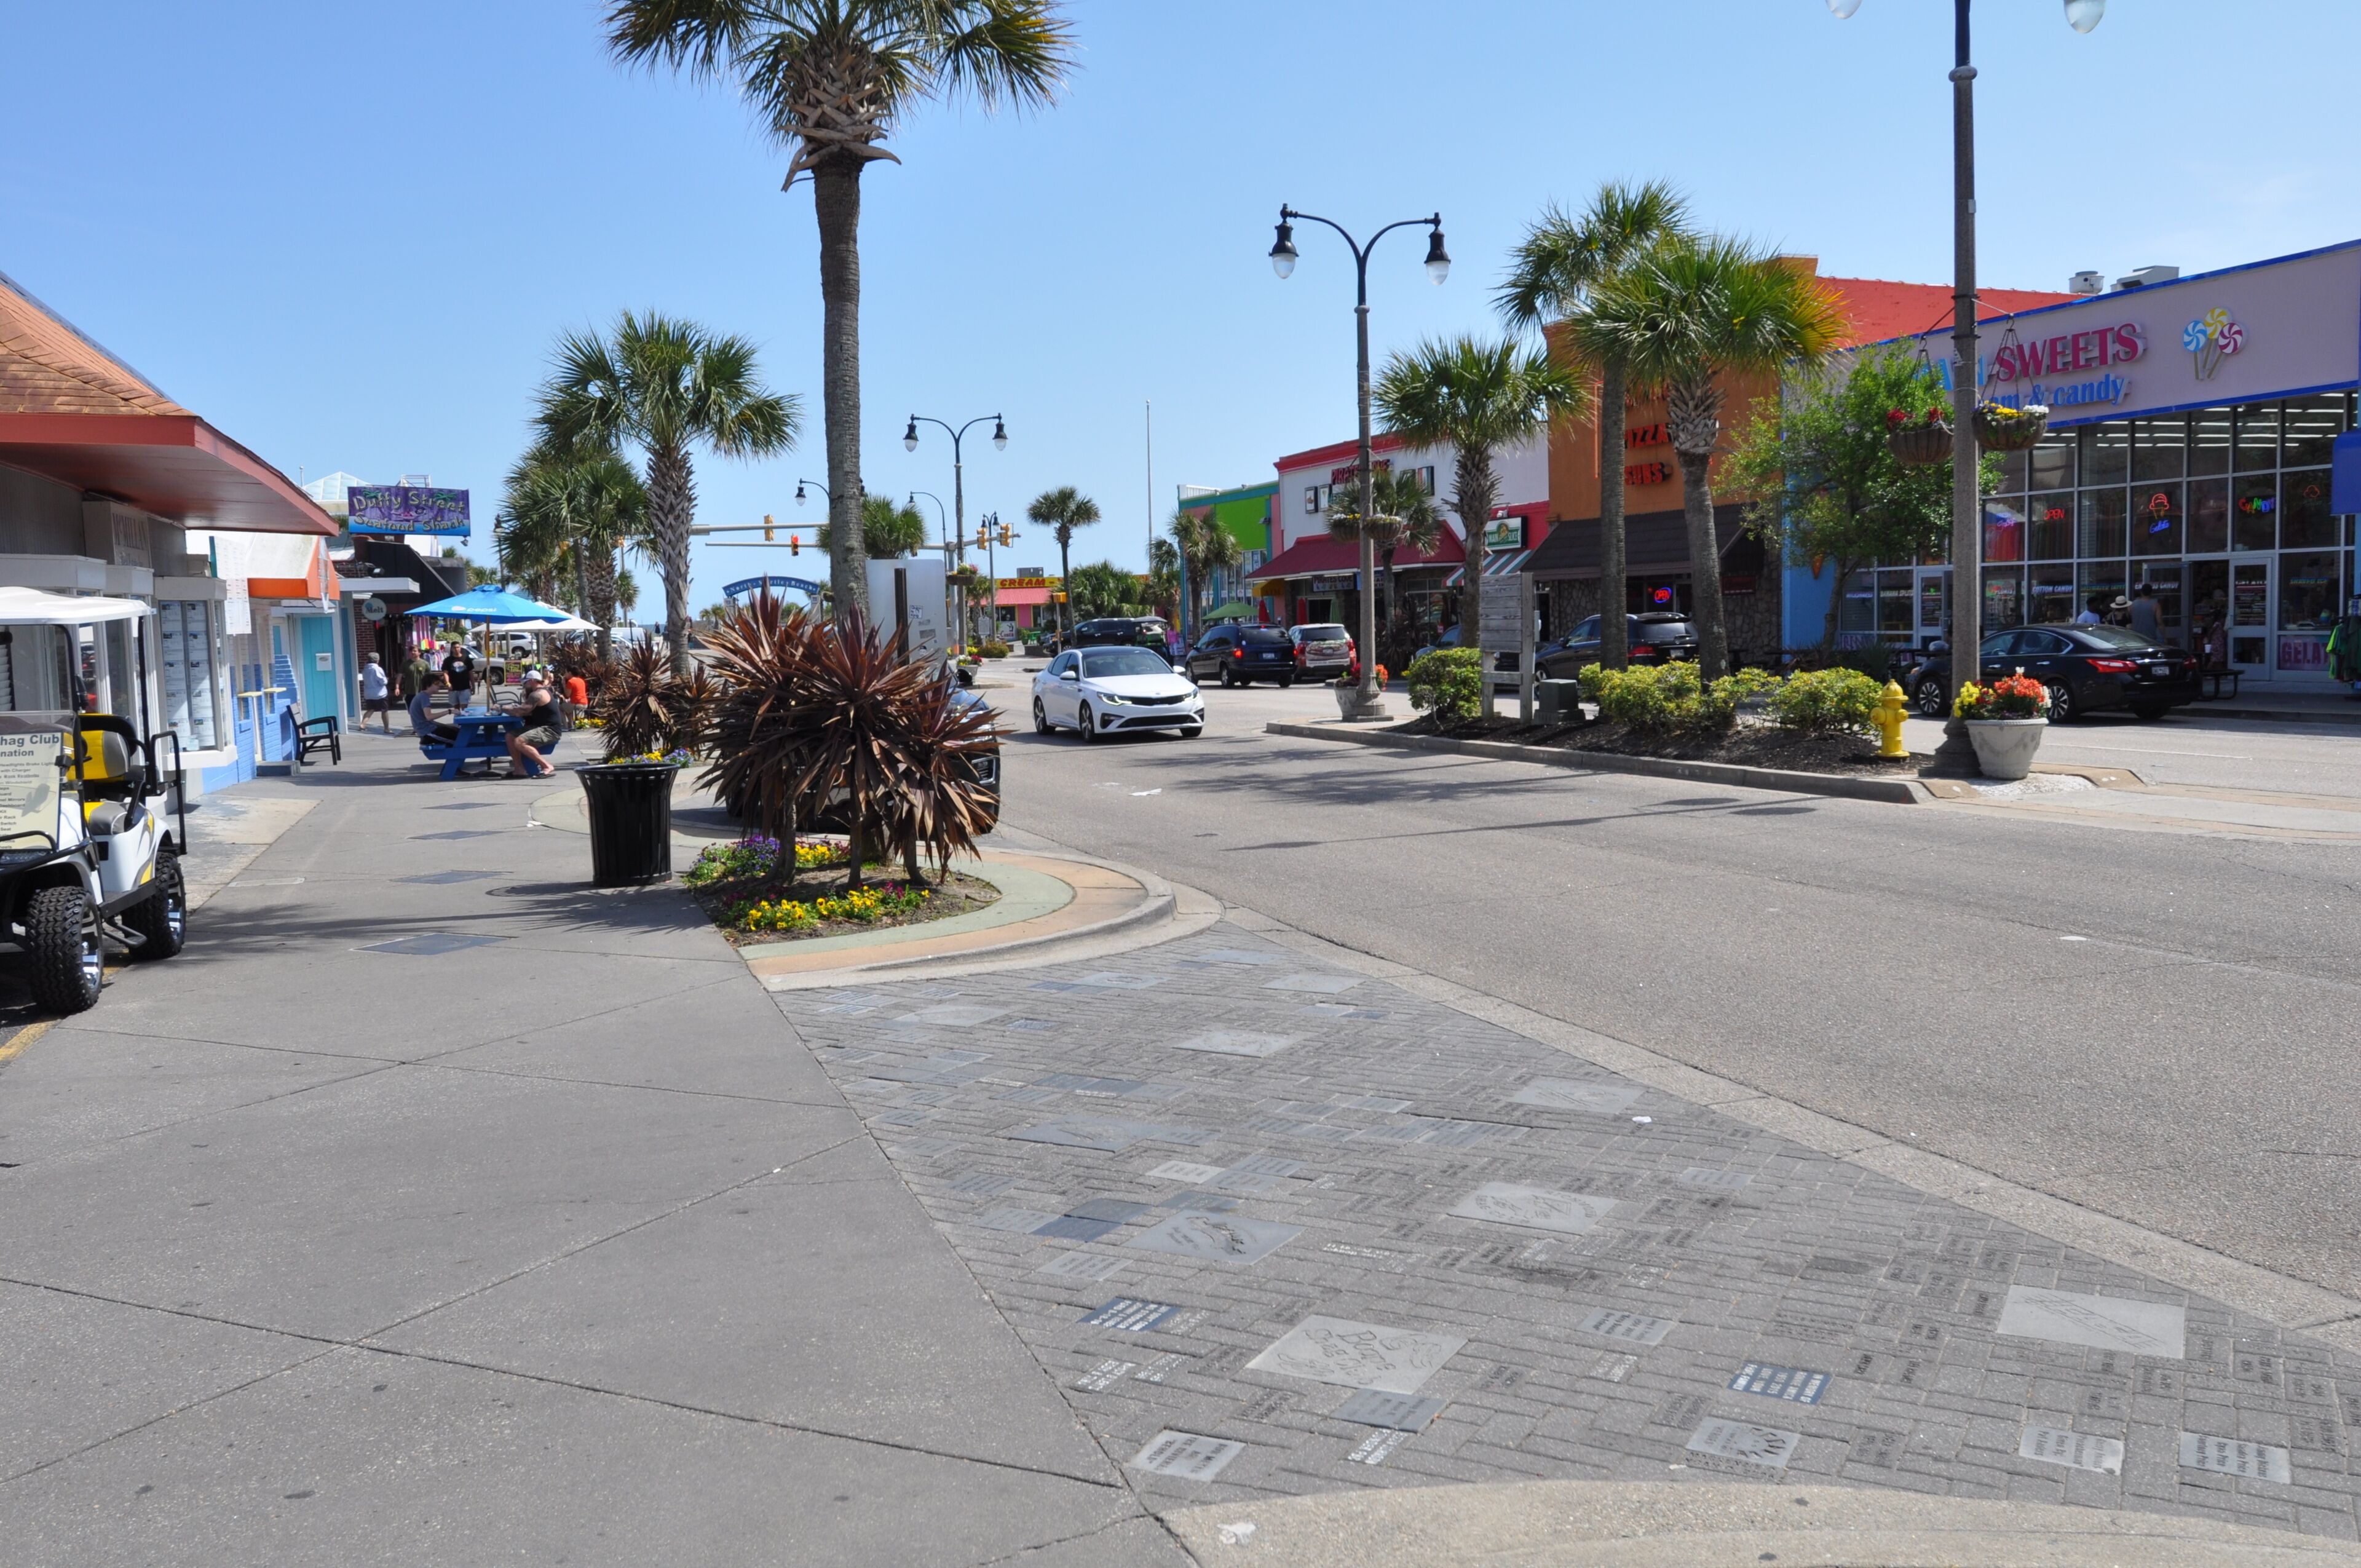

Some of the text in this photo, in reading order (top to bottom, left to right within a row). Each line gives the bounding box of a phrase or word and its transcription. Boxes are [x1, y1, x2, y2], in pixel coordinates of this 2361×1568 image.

[1996, 323, 2139, 382] SWEETS
[2054, 373, 2128, 405] candy
[1624, 462, 1663, 486] SUBS
[353, 491, 465, 513] Duffy Street
[2239, 497, 2277, 514] CANDY
[2043, 509, 2065, 520] OPEN
[354, 512, 465, 533] Seafood Shack
[1000, 578, 1046, 587] CREAM
[2054, 585, 2073, 593] CANDY
[1655, 590, 1669, 601] OPEN
[365, 603, 384, 614] Melt
[2282, 641, 2330, 665] GELAT
[30, 734, 60, 745] Club
[1801, 1378, 1821, 1397] MEMORY
[2195, 1454, 2208, 1467] Price
[2215, 1453, 2229, 1467] Price
[2236, 1459, 2250, 1474] Price
